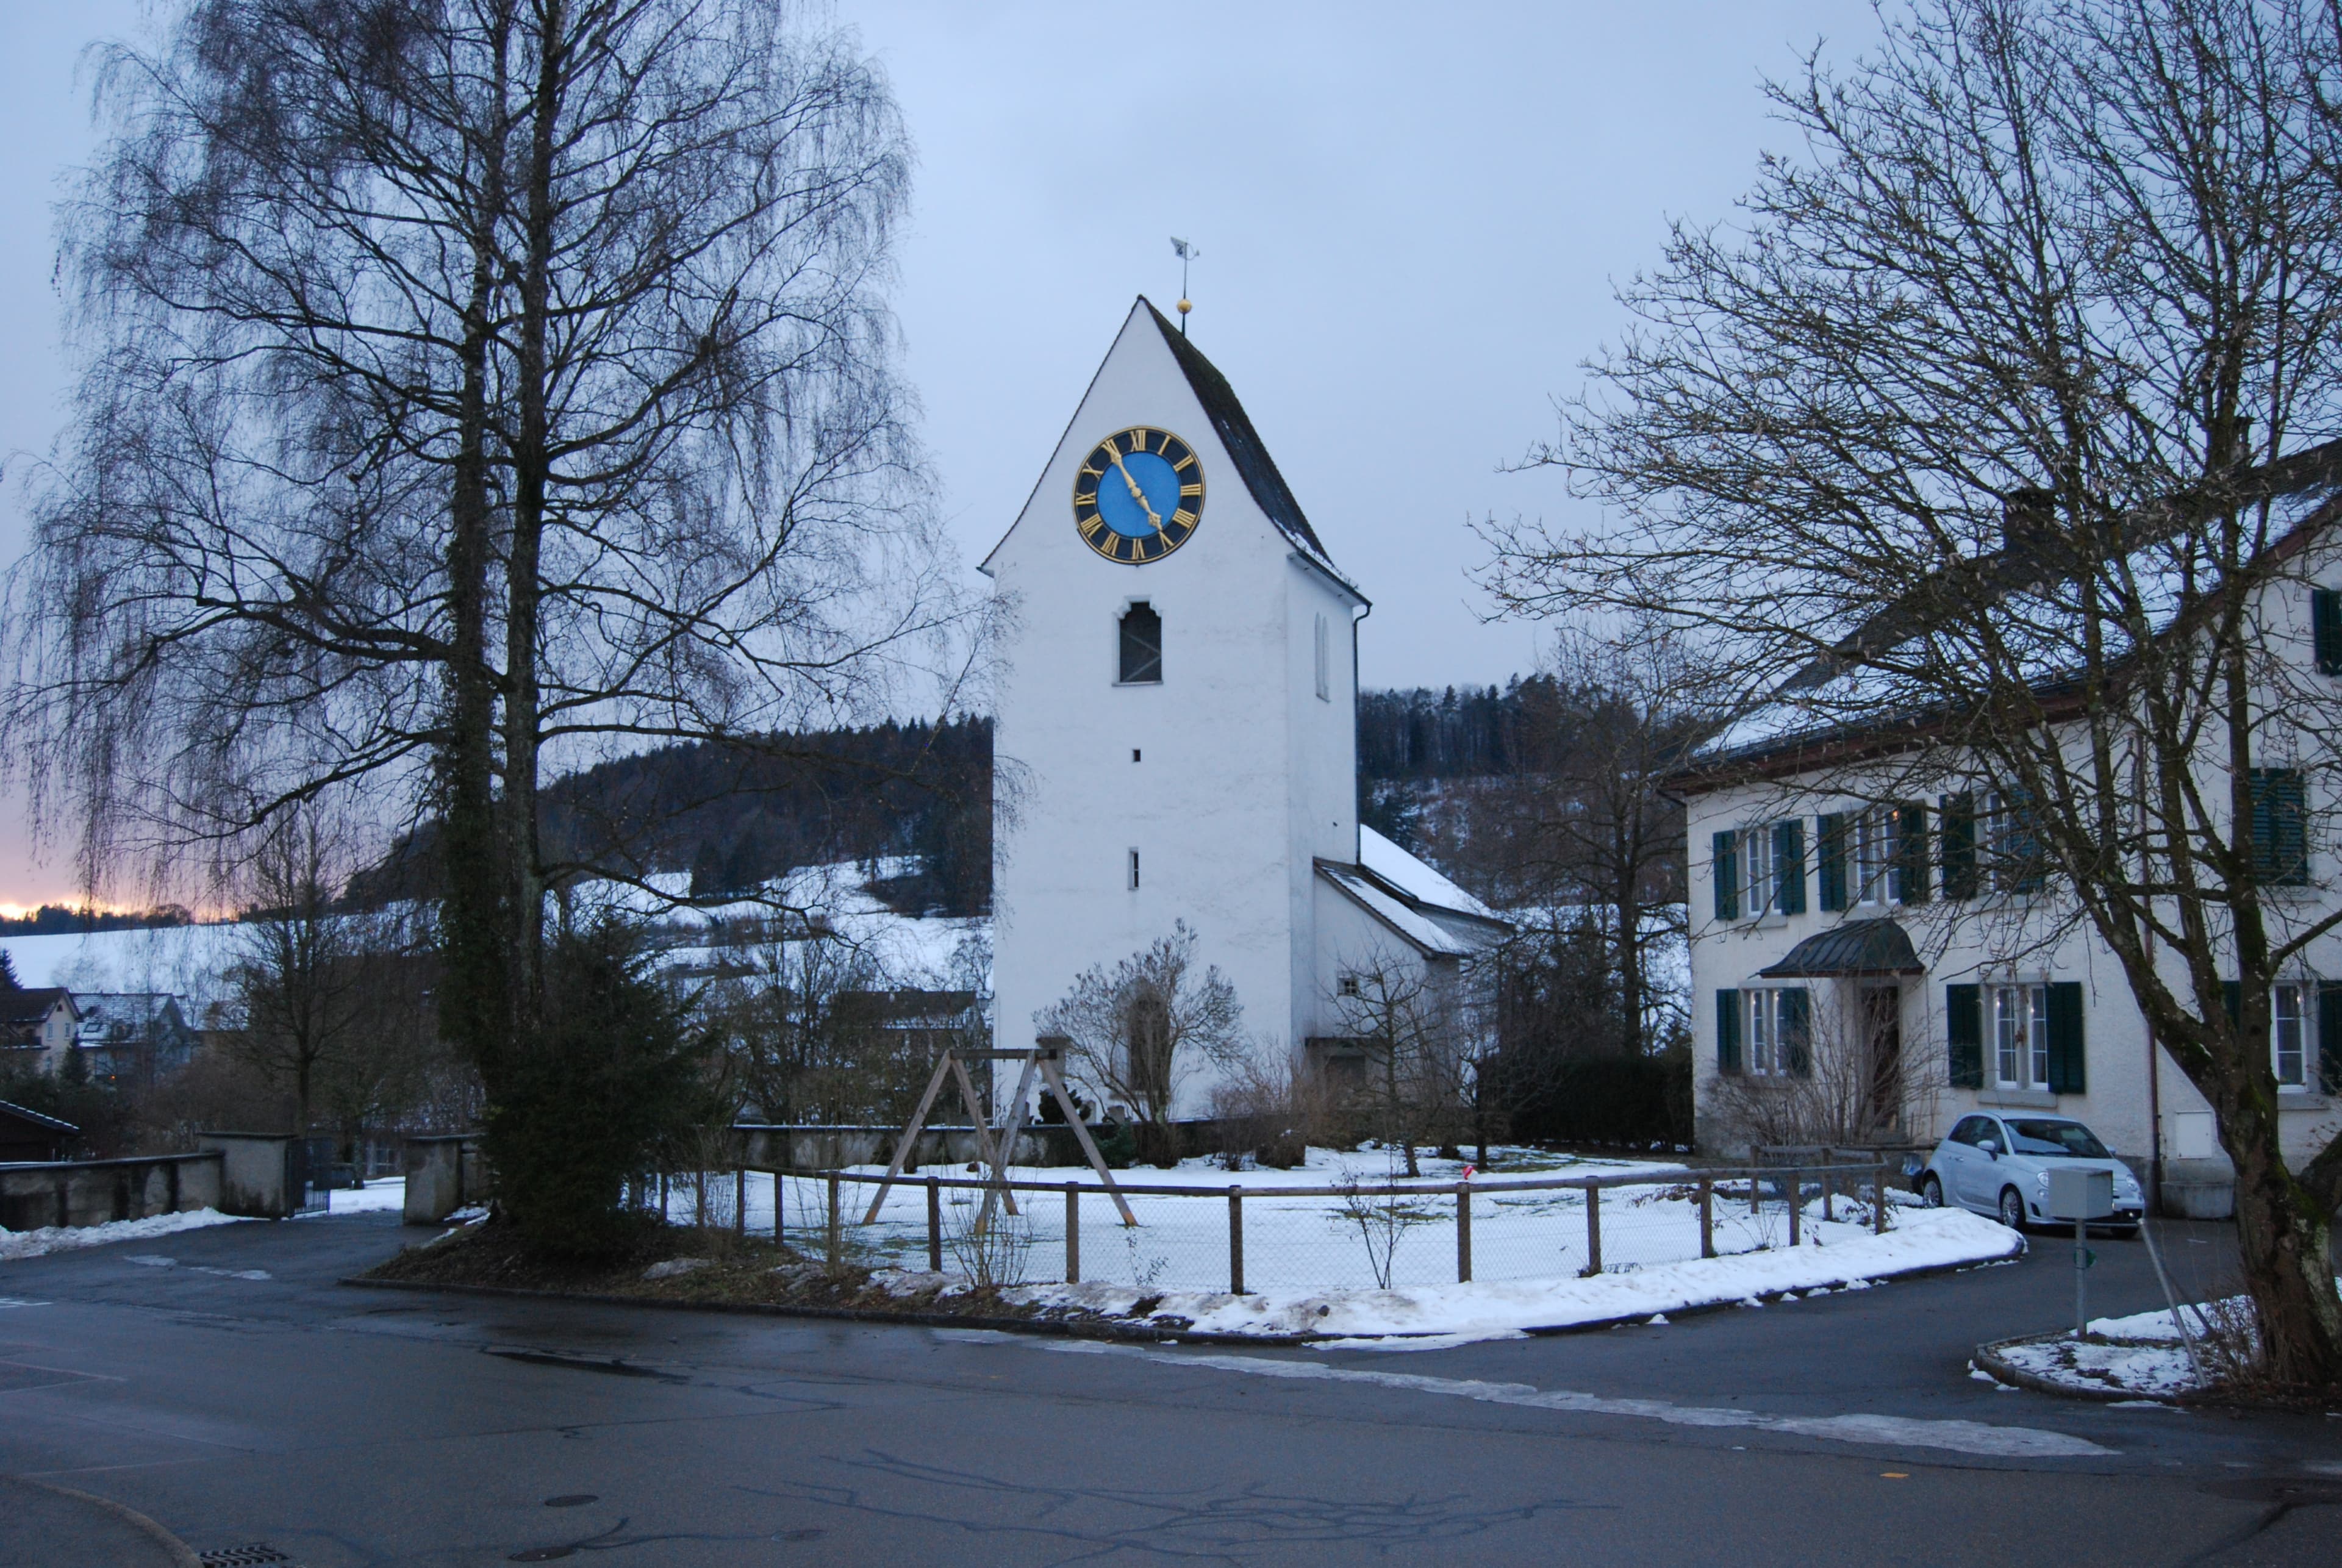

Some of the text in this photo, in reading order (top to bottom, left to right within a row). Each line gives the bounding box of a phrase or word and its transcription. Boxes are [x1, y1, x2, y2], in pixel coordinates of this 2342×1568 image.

[1130, 429, 1147, 452] XII
[1158, 434, 1172, 455] I
[1082, 462, 1104, 479] X
[1173, 454, 1194, 472] II
[1075, 492, 1097, 506] IX
[1180, 484, 1201, 496] III
[1080, 513, 1104, 538] VIII
[1172, 507, 1197, 529] IIII
[1101, 531, 1120, 556] VII
[1131, 538, 1145, 560] VI
[1159, 531, 1175, 551] V
